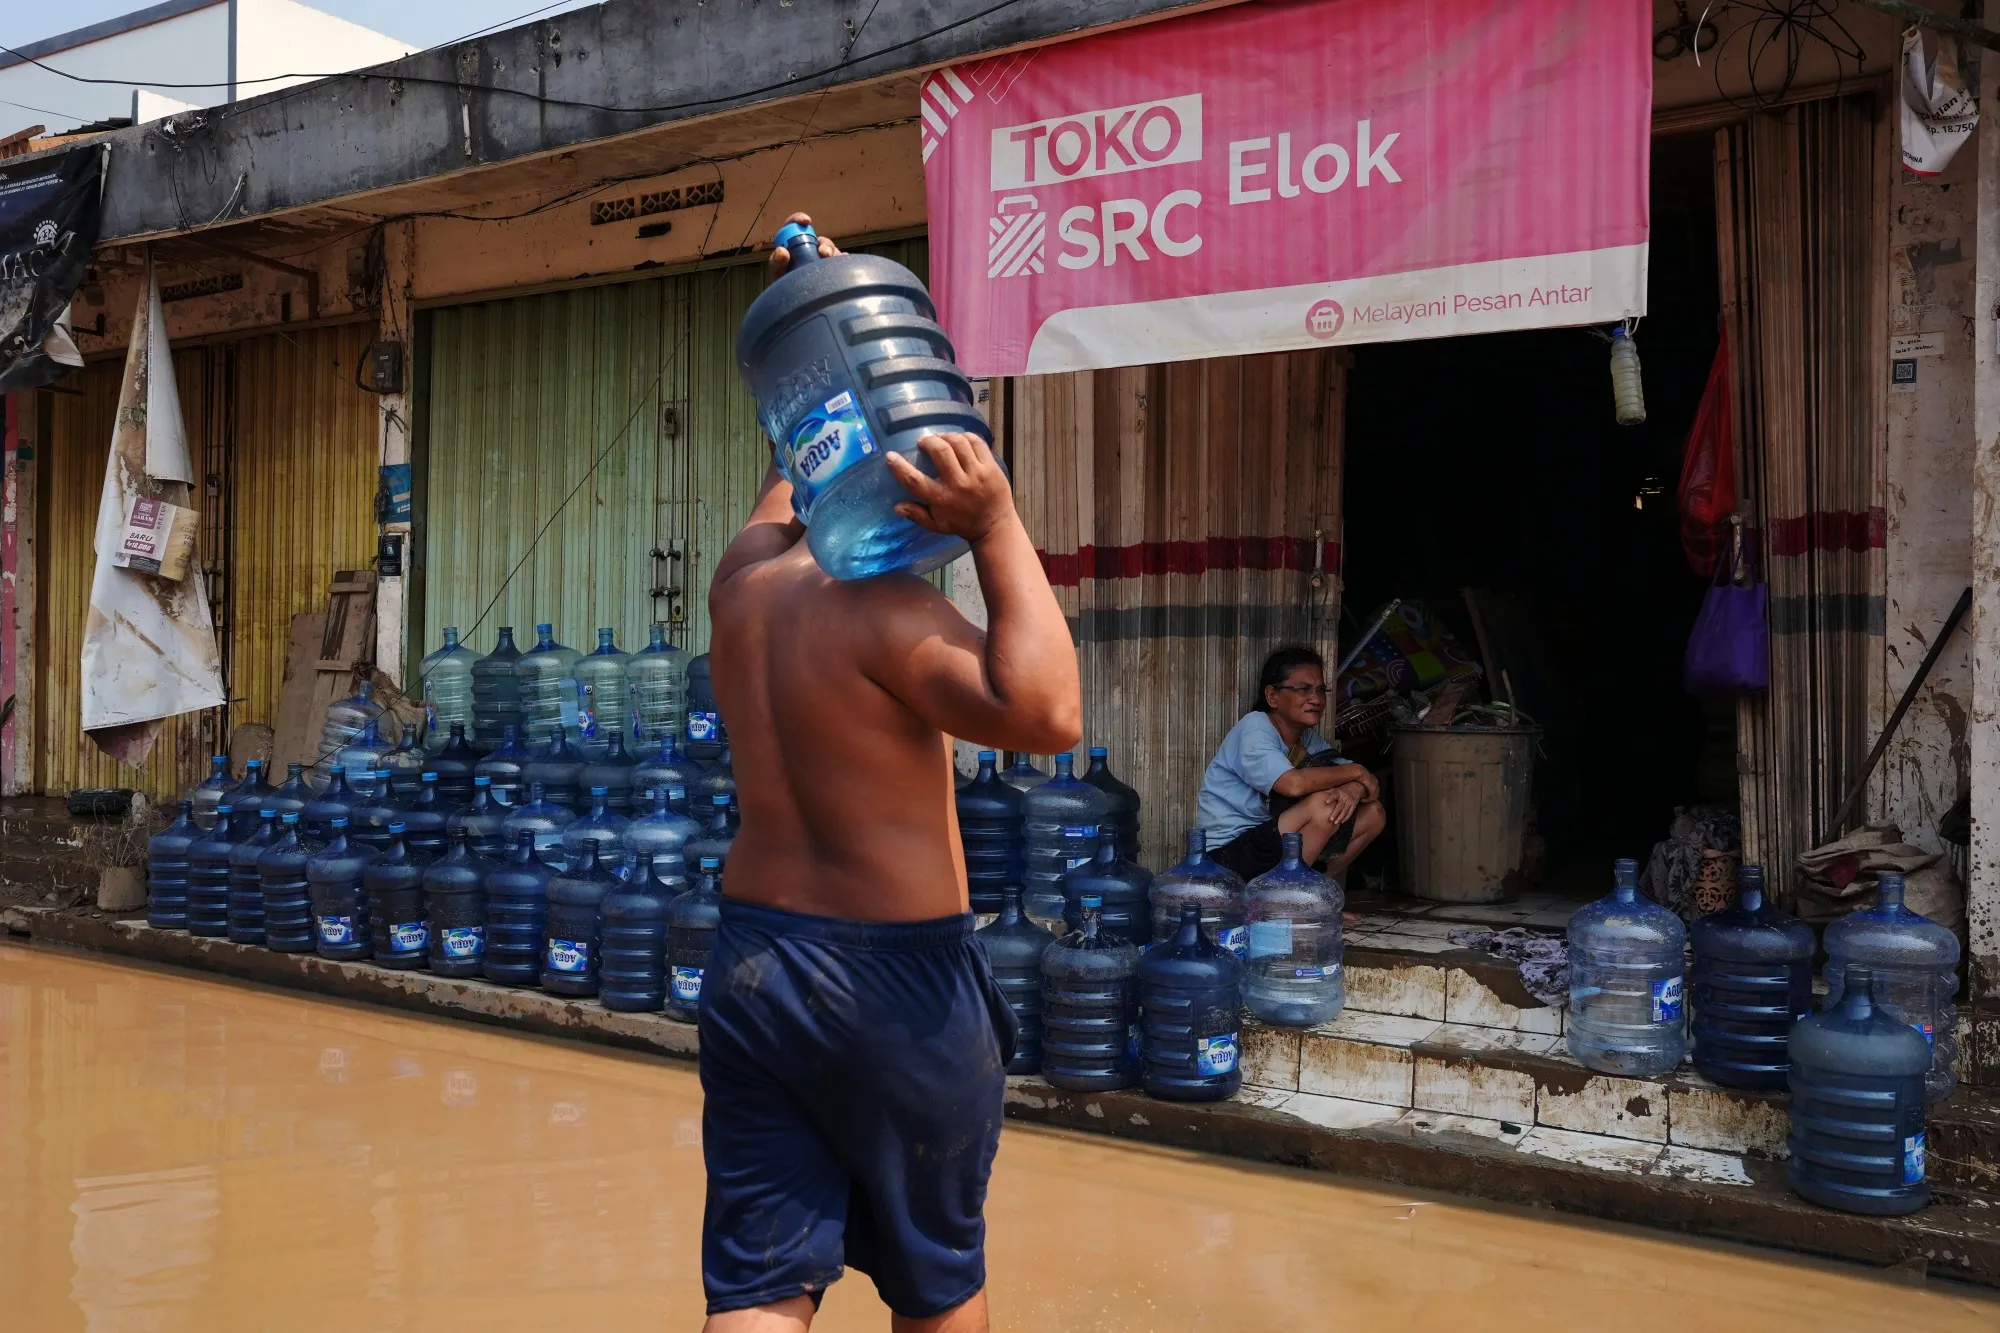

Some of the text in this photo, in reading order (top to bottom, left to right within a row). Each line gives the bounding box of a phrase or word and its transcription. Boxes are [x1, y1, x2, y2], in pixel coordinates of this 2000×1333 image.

[1942, 122, 1974, 133] 18.750
[1010, 105, 1182, 183] TOKO
[1229, 119, 1402, 206] Elok
[1057, 189, 1203, 270] SRC
[1352, 284, 1593, 325] Melayani Pesan Antar
[800, 429, 841, 478] AQUA
[129, 532, 153, 542] BARU
[323, 927, 343, 936] AQUA
[400, 932, 424, 944] AQUA
[450, 938, 475, 949] AQUA
[554, 952, 577, 963] AQUA
[1210, 1050, 1233, 1065] AQUA
